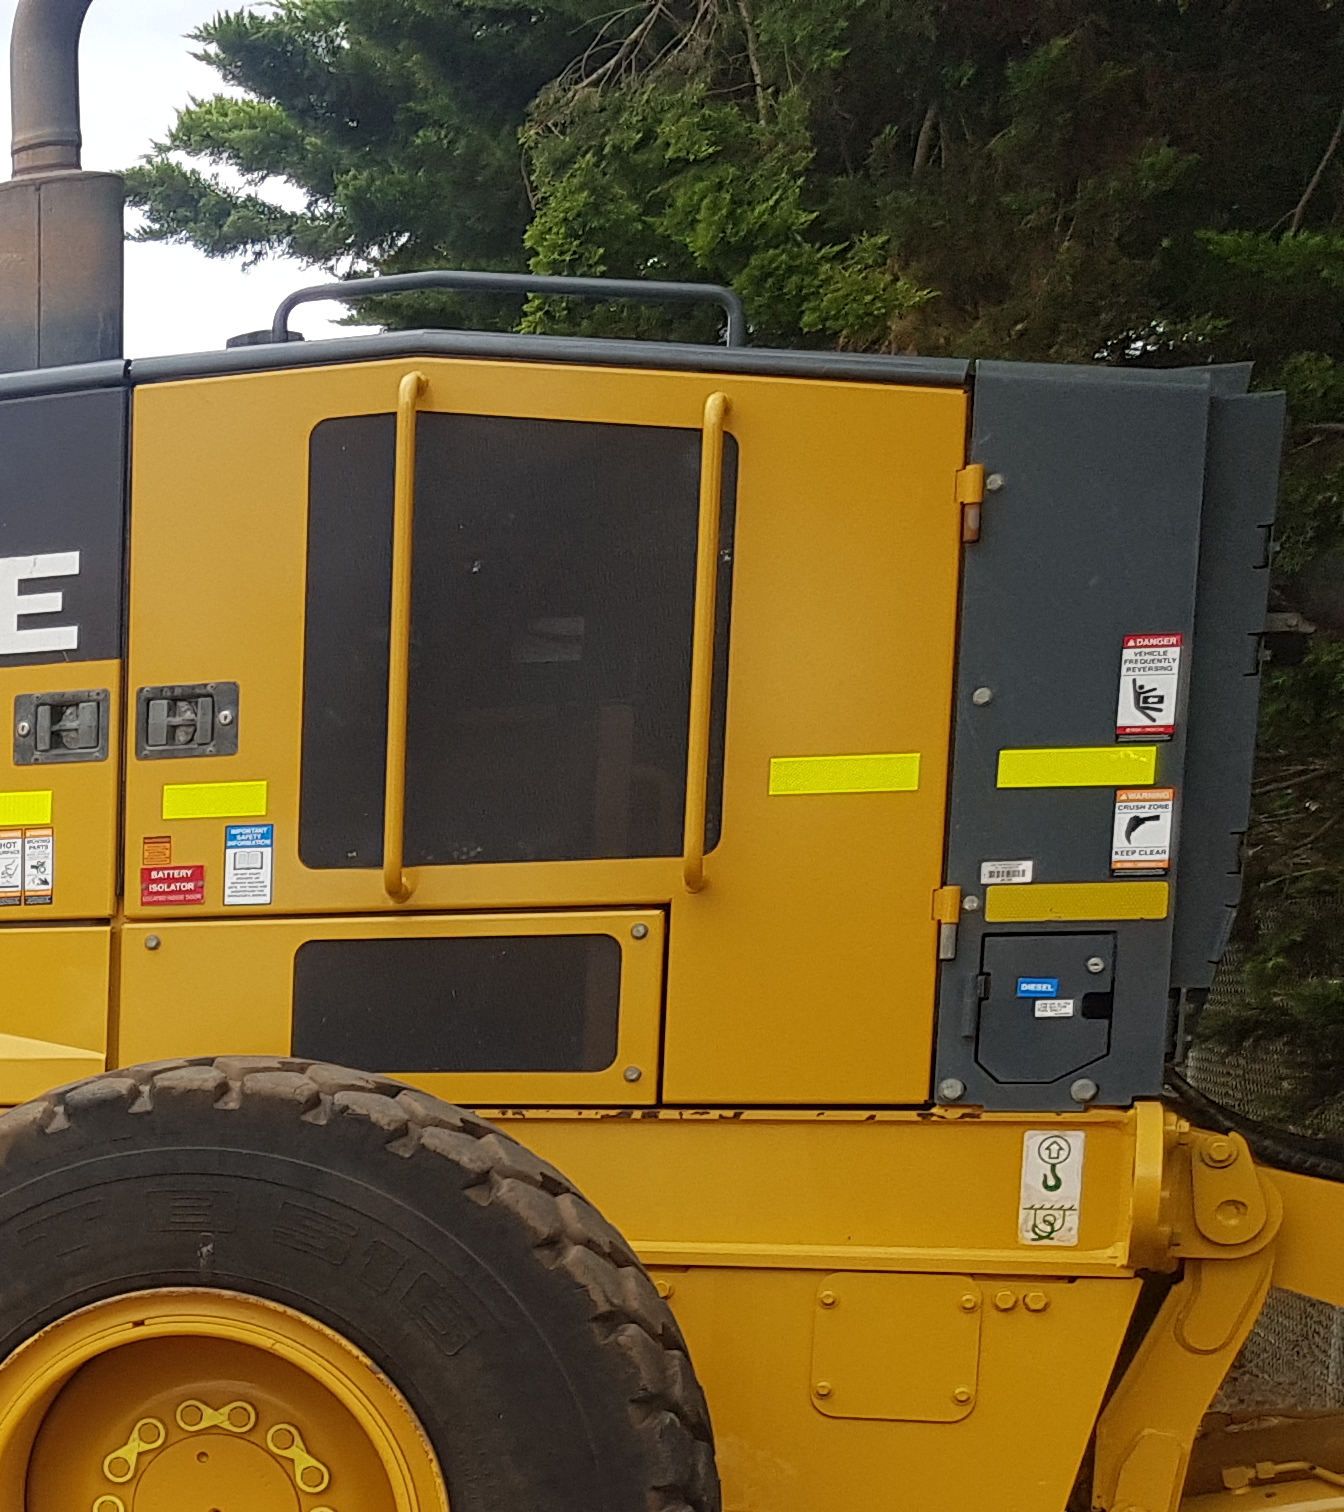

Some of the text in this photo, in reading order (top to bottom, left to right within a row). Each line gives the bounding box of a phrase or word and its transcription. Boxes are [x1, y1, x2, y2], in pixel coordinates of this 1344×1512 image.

[1136, 637, 1177, 646] DANGER
[1123, 657, 1177, 665] FREQUENTLY
[0, 841, 17, 849] HOT
[1138, 848, 1166, 856] CLEAR
[151, 868, 193, 879] BATTERY
[149, 882, 194, 892] ISOLATOR
[1020, 983, 1054, 991] DIESEL
